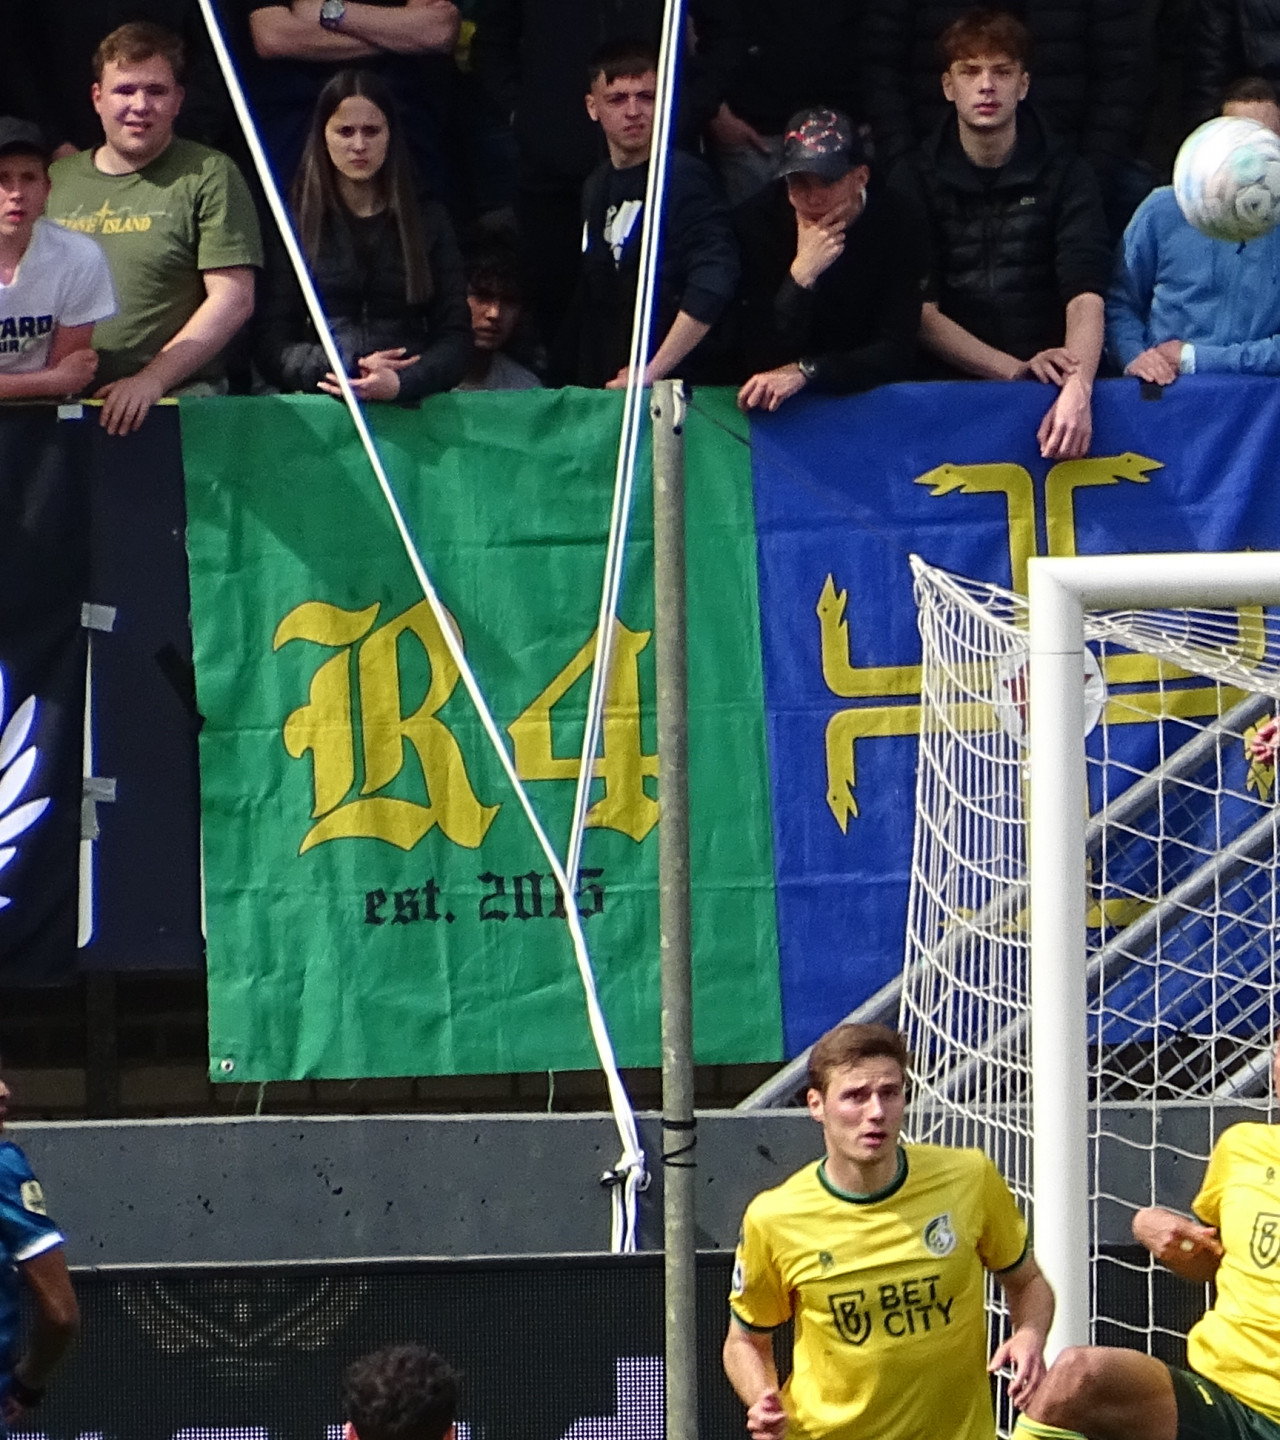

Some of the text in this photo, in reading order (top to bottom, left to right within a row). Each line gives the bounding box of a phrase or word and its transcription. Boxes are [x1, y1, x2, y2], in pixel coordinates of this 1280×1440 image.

[364, 876, 456, 927] est.
[878, 1274, 941, 1311] BET
[884, 1296, 955, 1338] CITY
